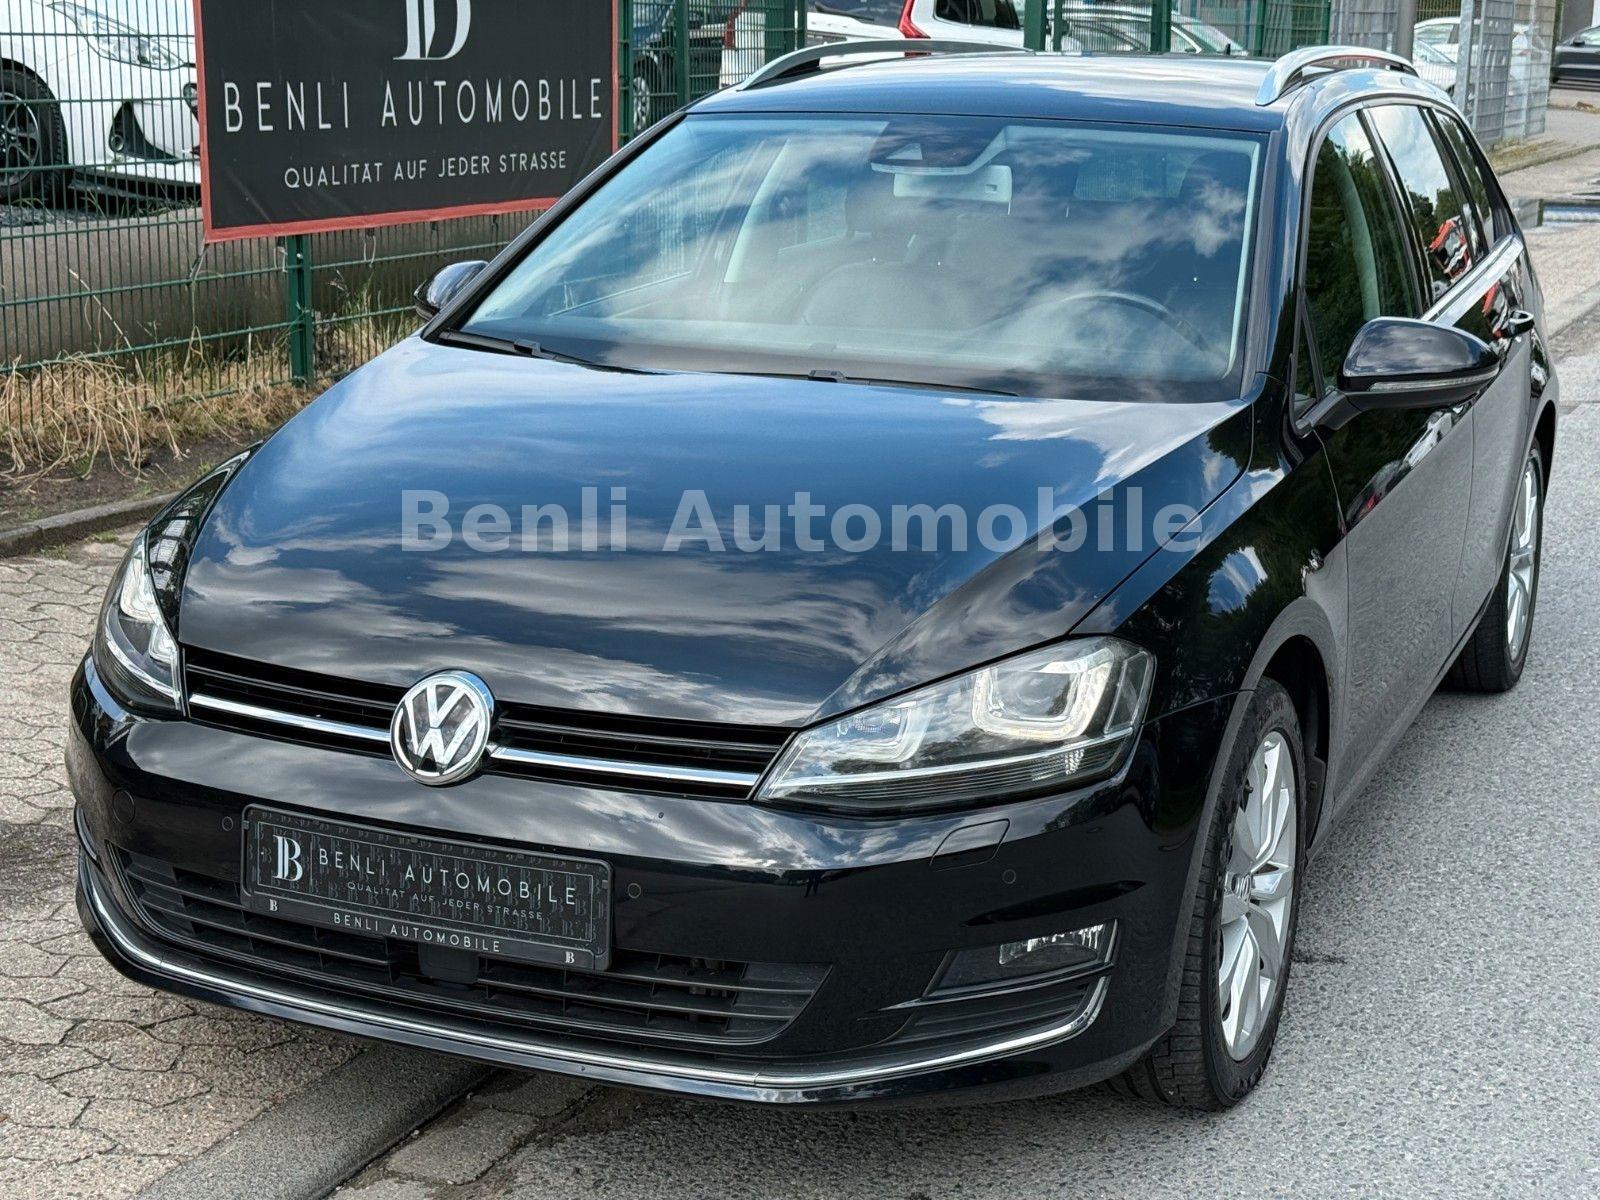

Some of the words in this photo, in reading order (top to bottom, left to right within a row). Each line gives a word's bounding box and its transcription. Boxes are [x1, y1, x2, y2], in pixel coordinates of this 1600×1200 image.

[223, 81, 350, 133] BENLI
[381, 78, 602, 128] AUTOMOBILE
[394, 157, 427, 181] AUF
[438, 154, 490, 178] JEDER
[499, 150, 567, 174] STRASSE
[394, 676, 488, 780] VW
[319, 848, 386, 877] BENLI
[404, 863, 577, 906] AUTOMOBILE
[333, 912, 379, 932] BENLI
[390, 924, 500, 953] AUTOMOBILE
[442, 897, 481, 912] JEDER
[486, 904, 543, 921] STRASSE
